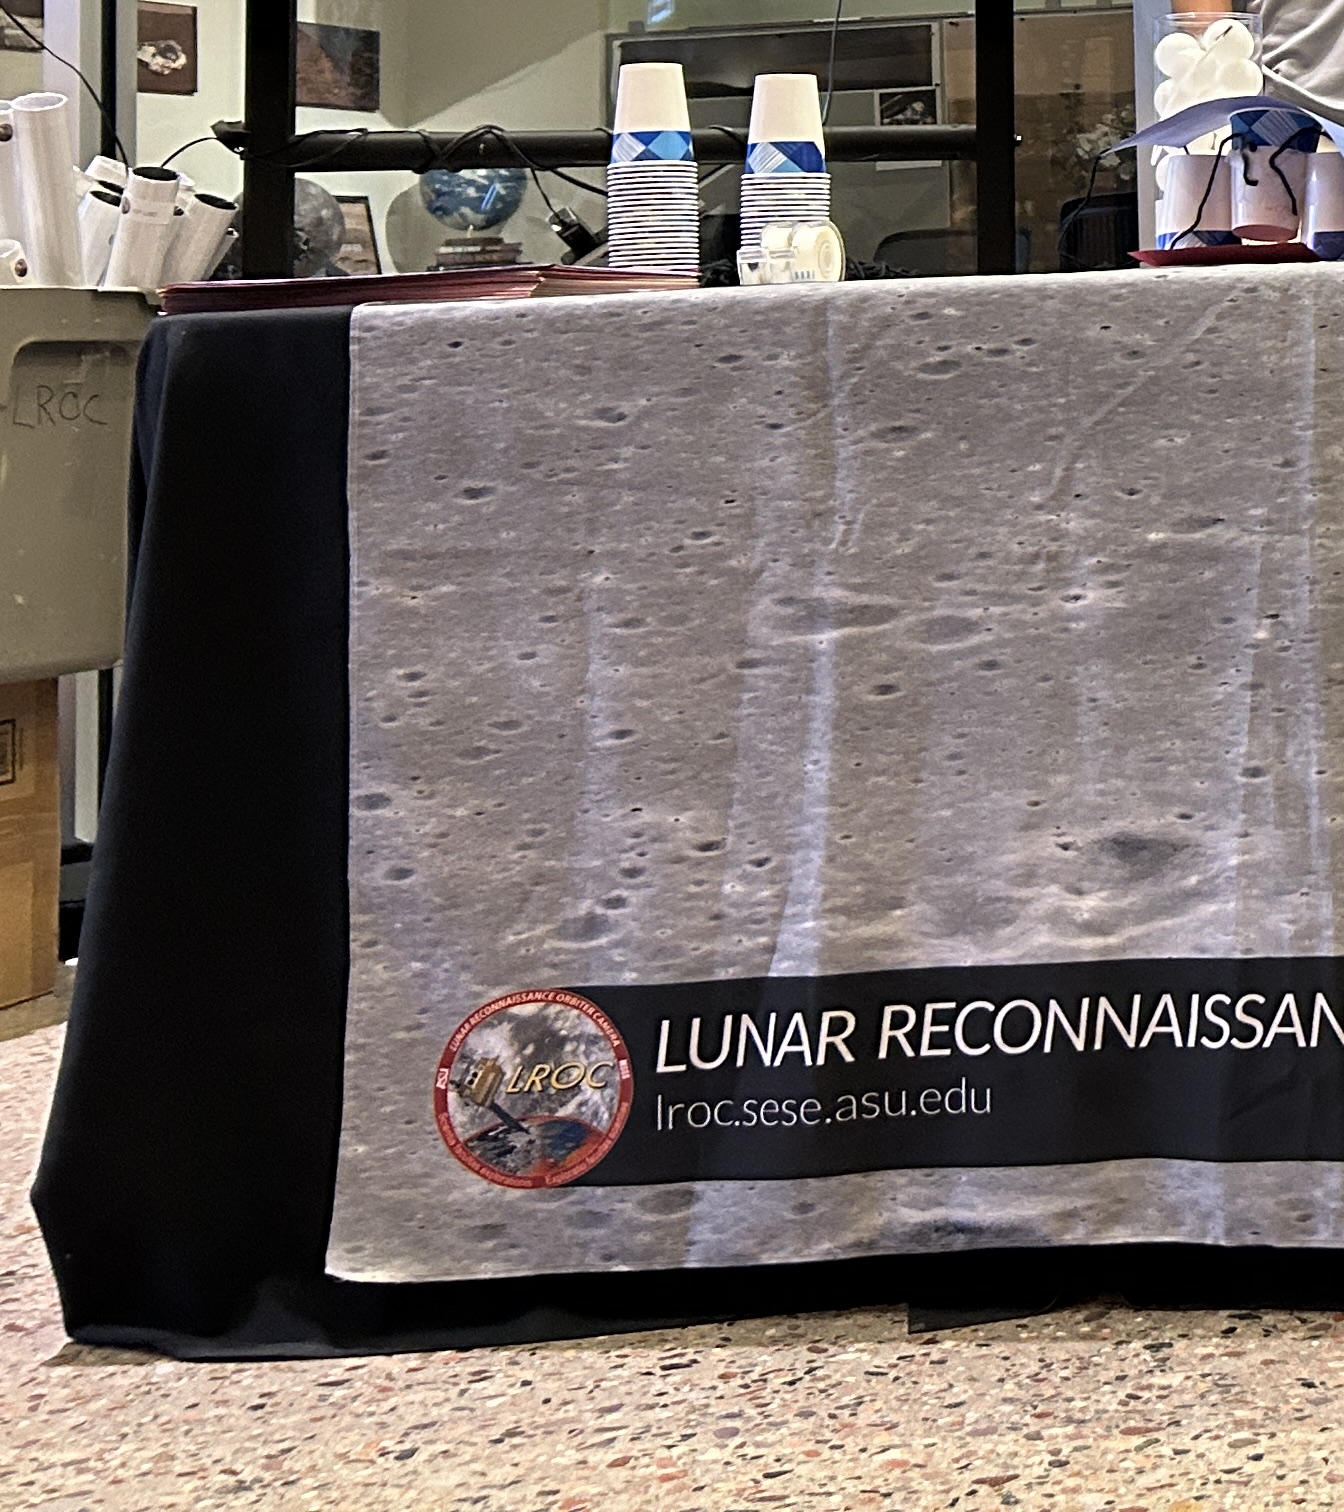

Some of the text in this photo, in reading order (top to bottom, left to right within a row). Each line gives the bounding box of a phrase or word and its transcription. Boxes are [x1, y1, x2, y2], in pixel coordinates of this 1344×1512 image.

[13, 384, 108, 429] LROC
[449, 991, 622, 1052] LUNAR RECONNAISSANCE ORBITER CAMERA
[655, 1010, 856, 1074] LUNAR
[505, 1061, 615, 1095] LROC
[656, 1077, 993, 1133] lroc.sese.asu.edu
